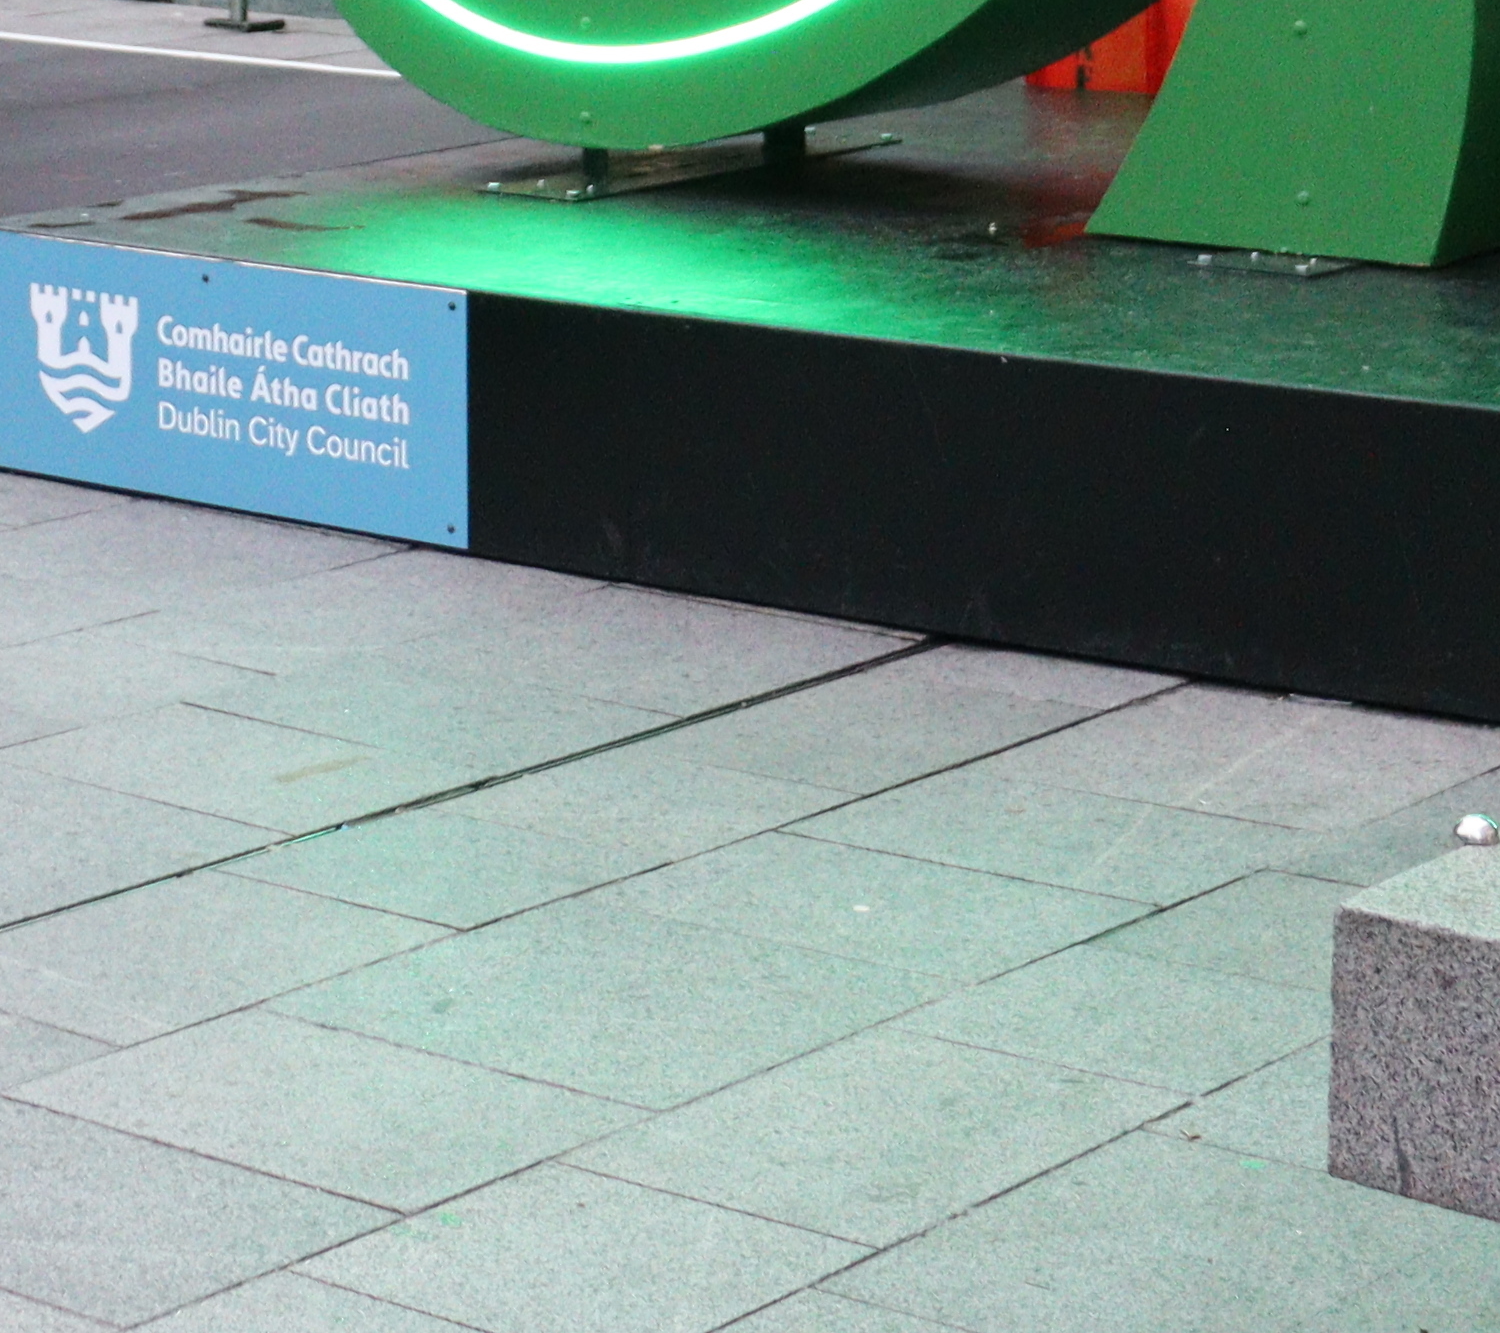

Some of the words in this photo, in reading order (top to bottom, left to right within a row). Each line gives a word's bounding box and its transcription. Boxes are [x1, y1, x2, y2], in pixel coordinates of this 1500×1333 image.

[157, 314, 288, 364] Comhairle
[292, 334, 409, 380] Cathrach
[158, 357, 243, 400] Bhaile
[250, 364, 318, 411] Átha
[324, 383, 410, 426] Cliath
[158, 400, 241, 441] Dublin
[249, 415, 299, 457] City
[306, 425, 410, 469] Council
